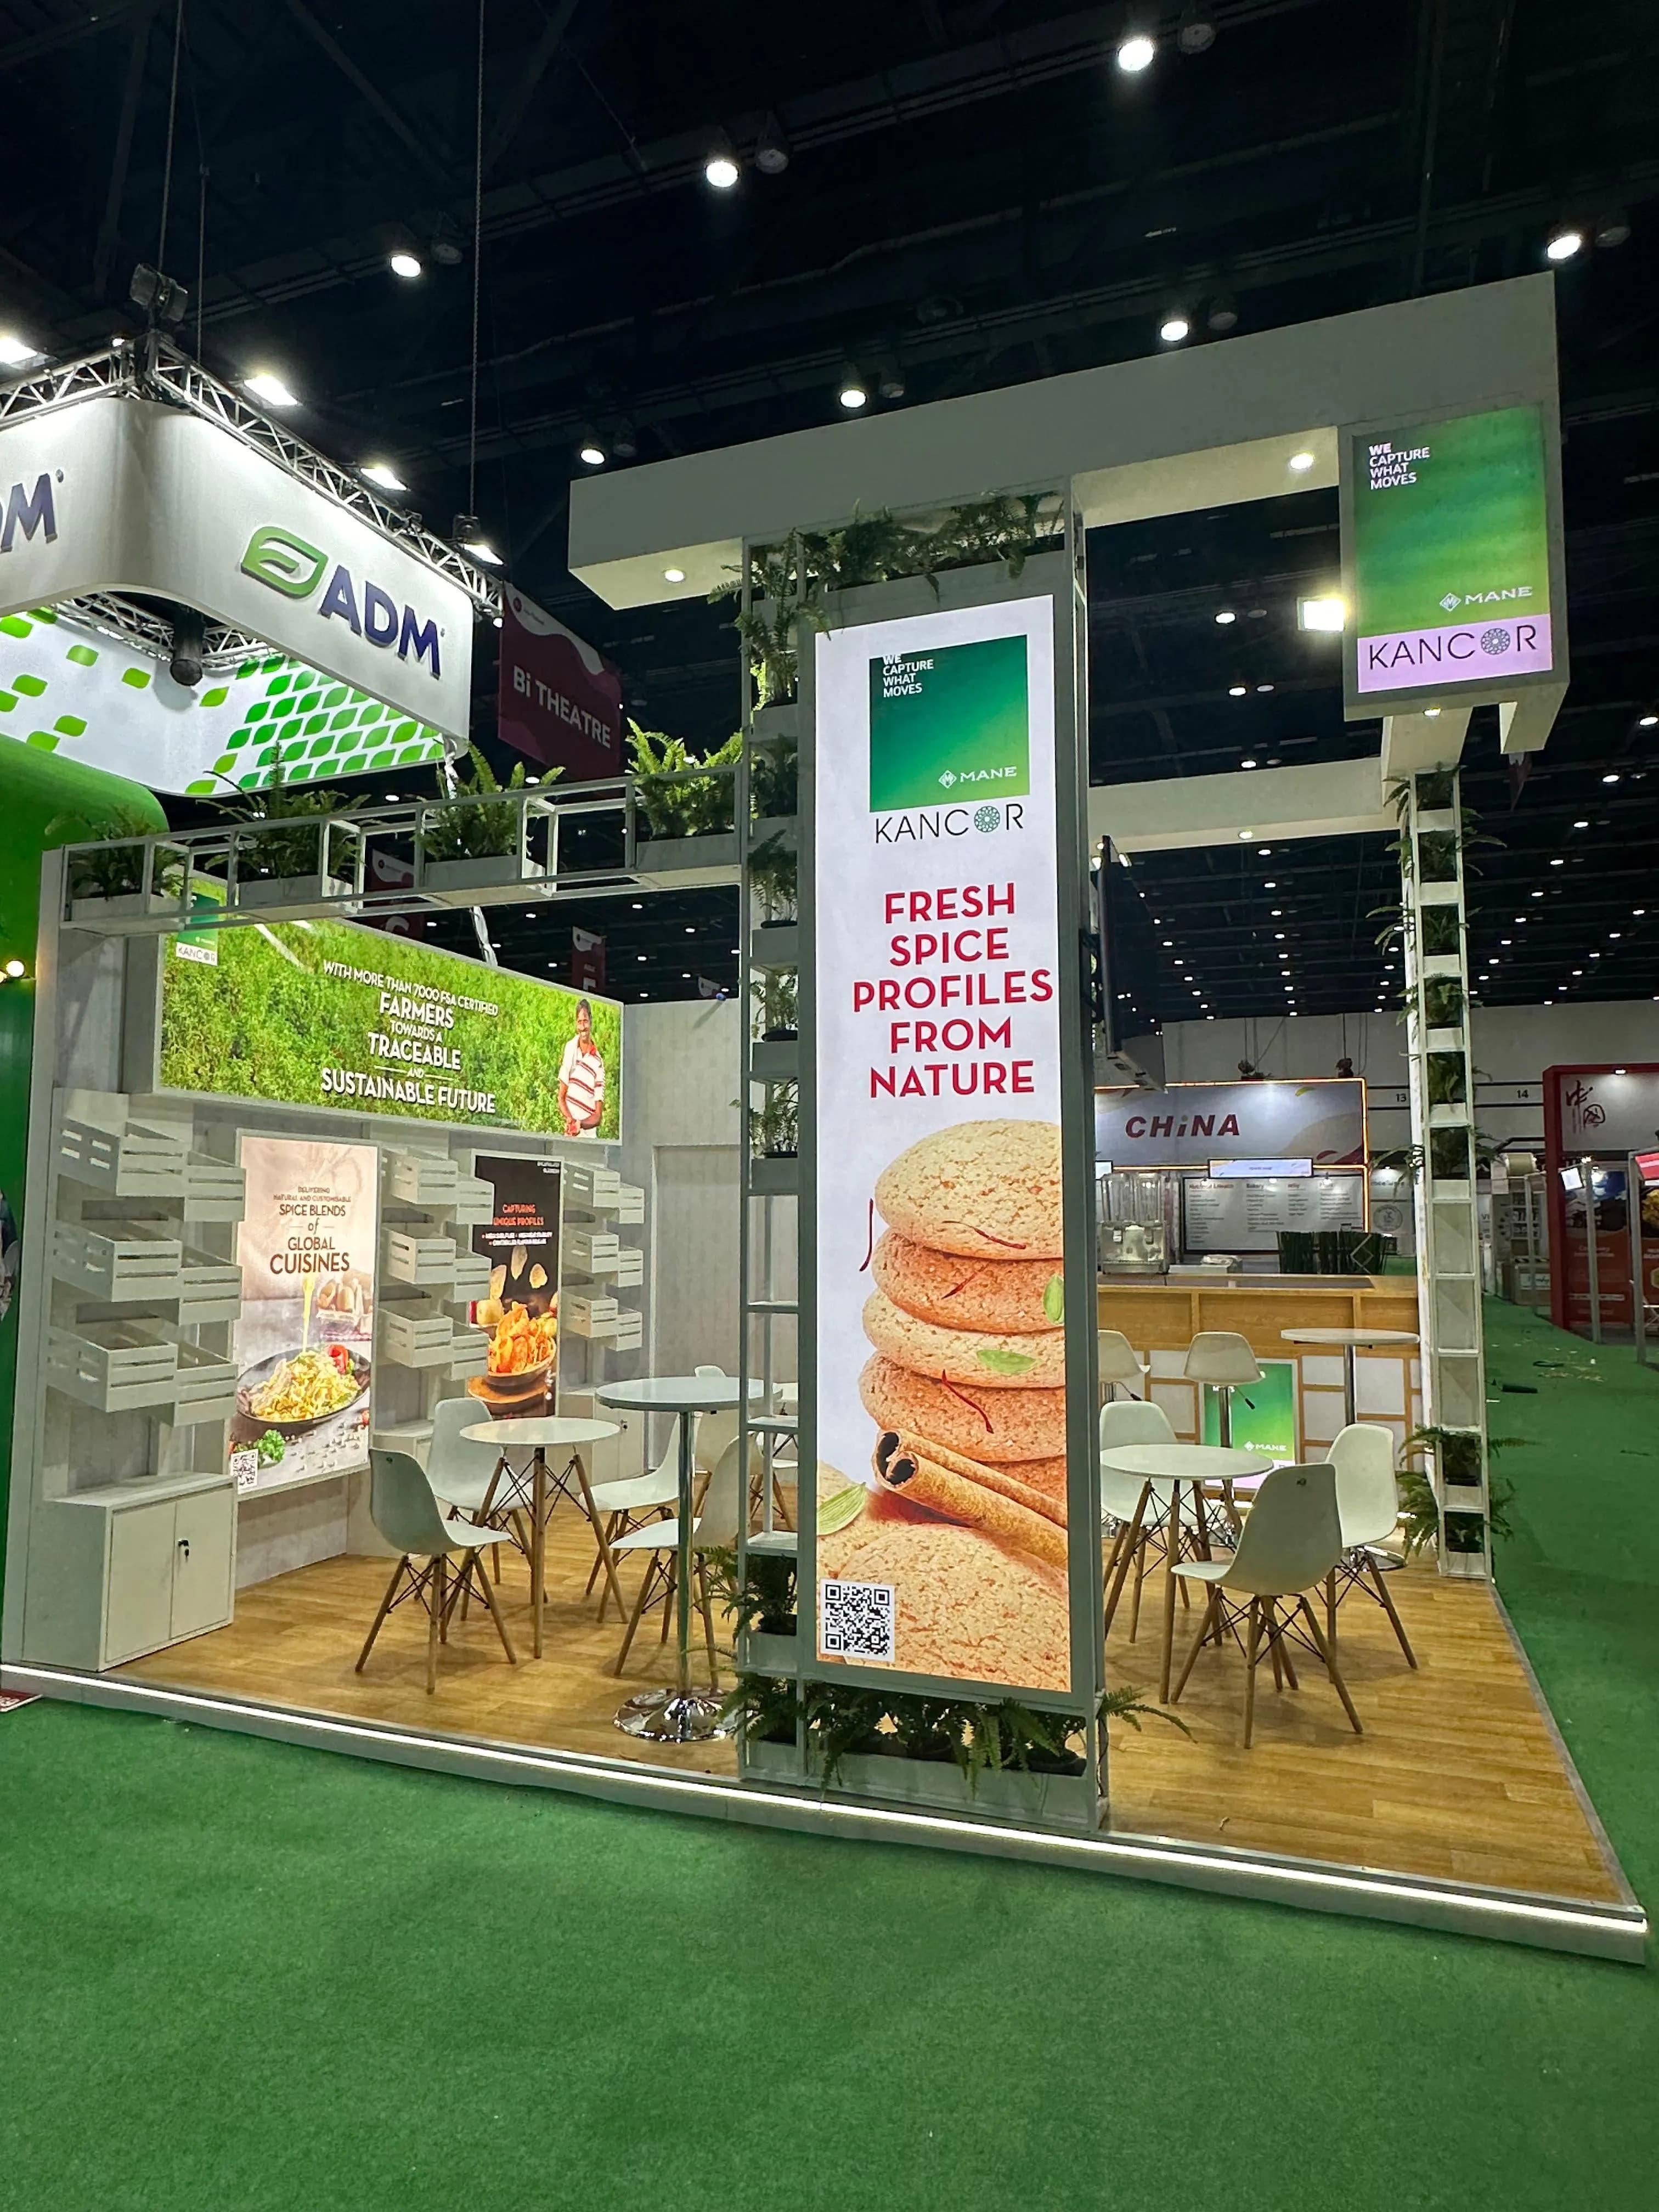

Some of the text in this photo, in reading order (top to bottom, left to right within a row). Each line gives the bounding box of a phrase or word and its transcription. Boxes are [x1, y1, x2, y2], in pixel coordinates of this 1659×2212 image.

[1369, 442, 1392, 456] WE
[1369, 447, 1430, 467] CAPTURE
[1370, 462, 1409, 478] WHAT
[1370, 472, 1417, 490] MOVES
[1465, 586, 1533, 605] MANE
[319, 564, 441, 680] ADM
[1369, 625, 1537, 670] KANCOR
[883, 654, 902, 665] WE
[883, 659, 934, 676] CAPTURE
[883, 673, 916, 687] WHAT
[883, 683, 923, 698] MOVES
[514, 665, 611, 749] Bi THEATRE
[960, 766, 1018, 783] MANE
[875, 803, 1024, 844] KANCOR
[885, 882, 1015, 924] FRESH
[890, 927, 1009, 967] SPICE
[323, 960, 499, 1016] WITH MORE THAN 7000 FSA CERTIFIED
[854, 969, 1053, 1013] PROFILES
[379, 991, 455, 1030] FARMERS
[390, 1020, 443, 1043] TOWARDS A
[891, 1017, 1011, 1053] FROM
[368, 1032, 461, 1070] TRACEABLE
[407, 1068, 425, 1079] AND
[871, 1060, 1035, 1098] NATURE
[321, 1068, 496, 1114] SUSTAINABLE FUTURE
[1396, 1093, 1407, 1102] 13
[1516, 1090, 1529, 1099] 14
[279, 1204, 346, 1216] SPICE BLENDS
[308, 1217, 320, 1235] of
[288, 1237, 336, 1250] GLOBAL
[270, 1252, 350, 1274] CUISINES
